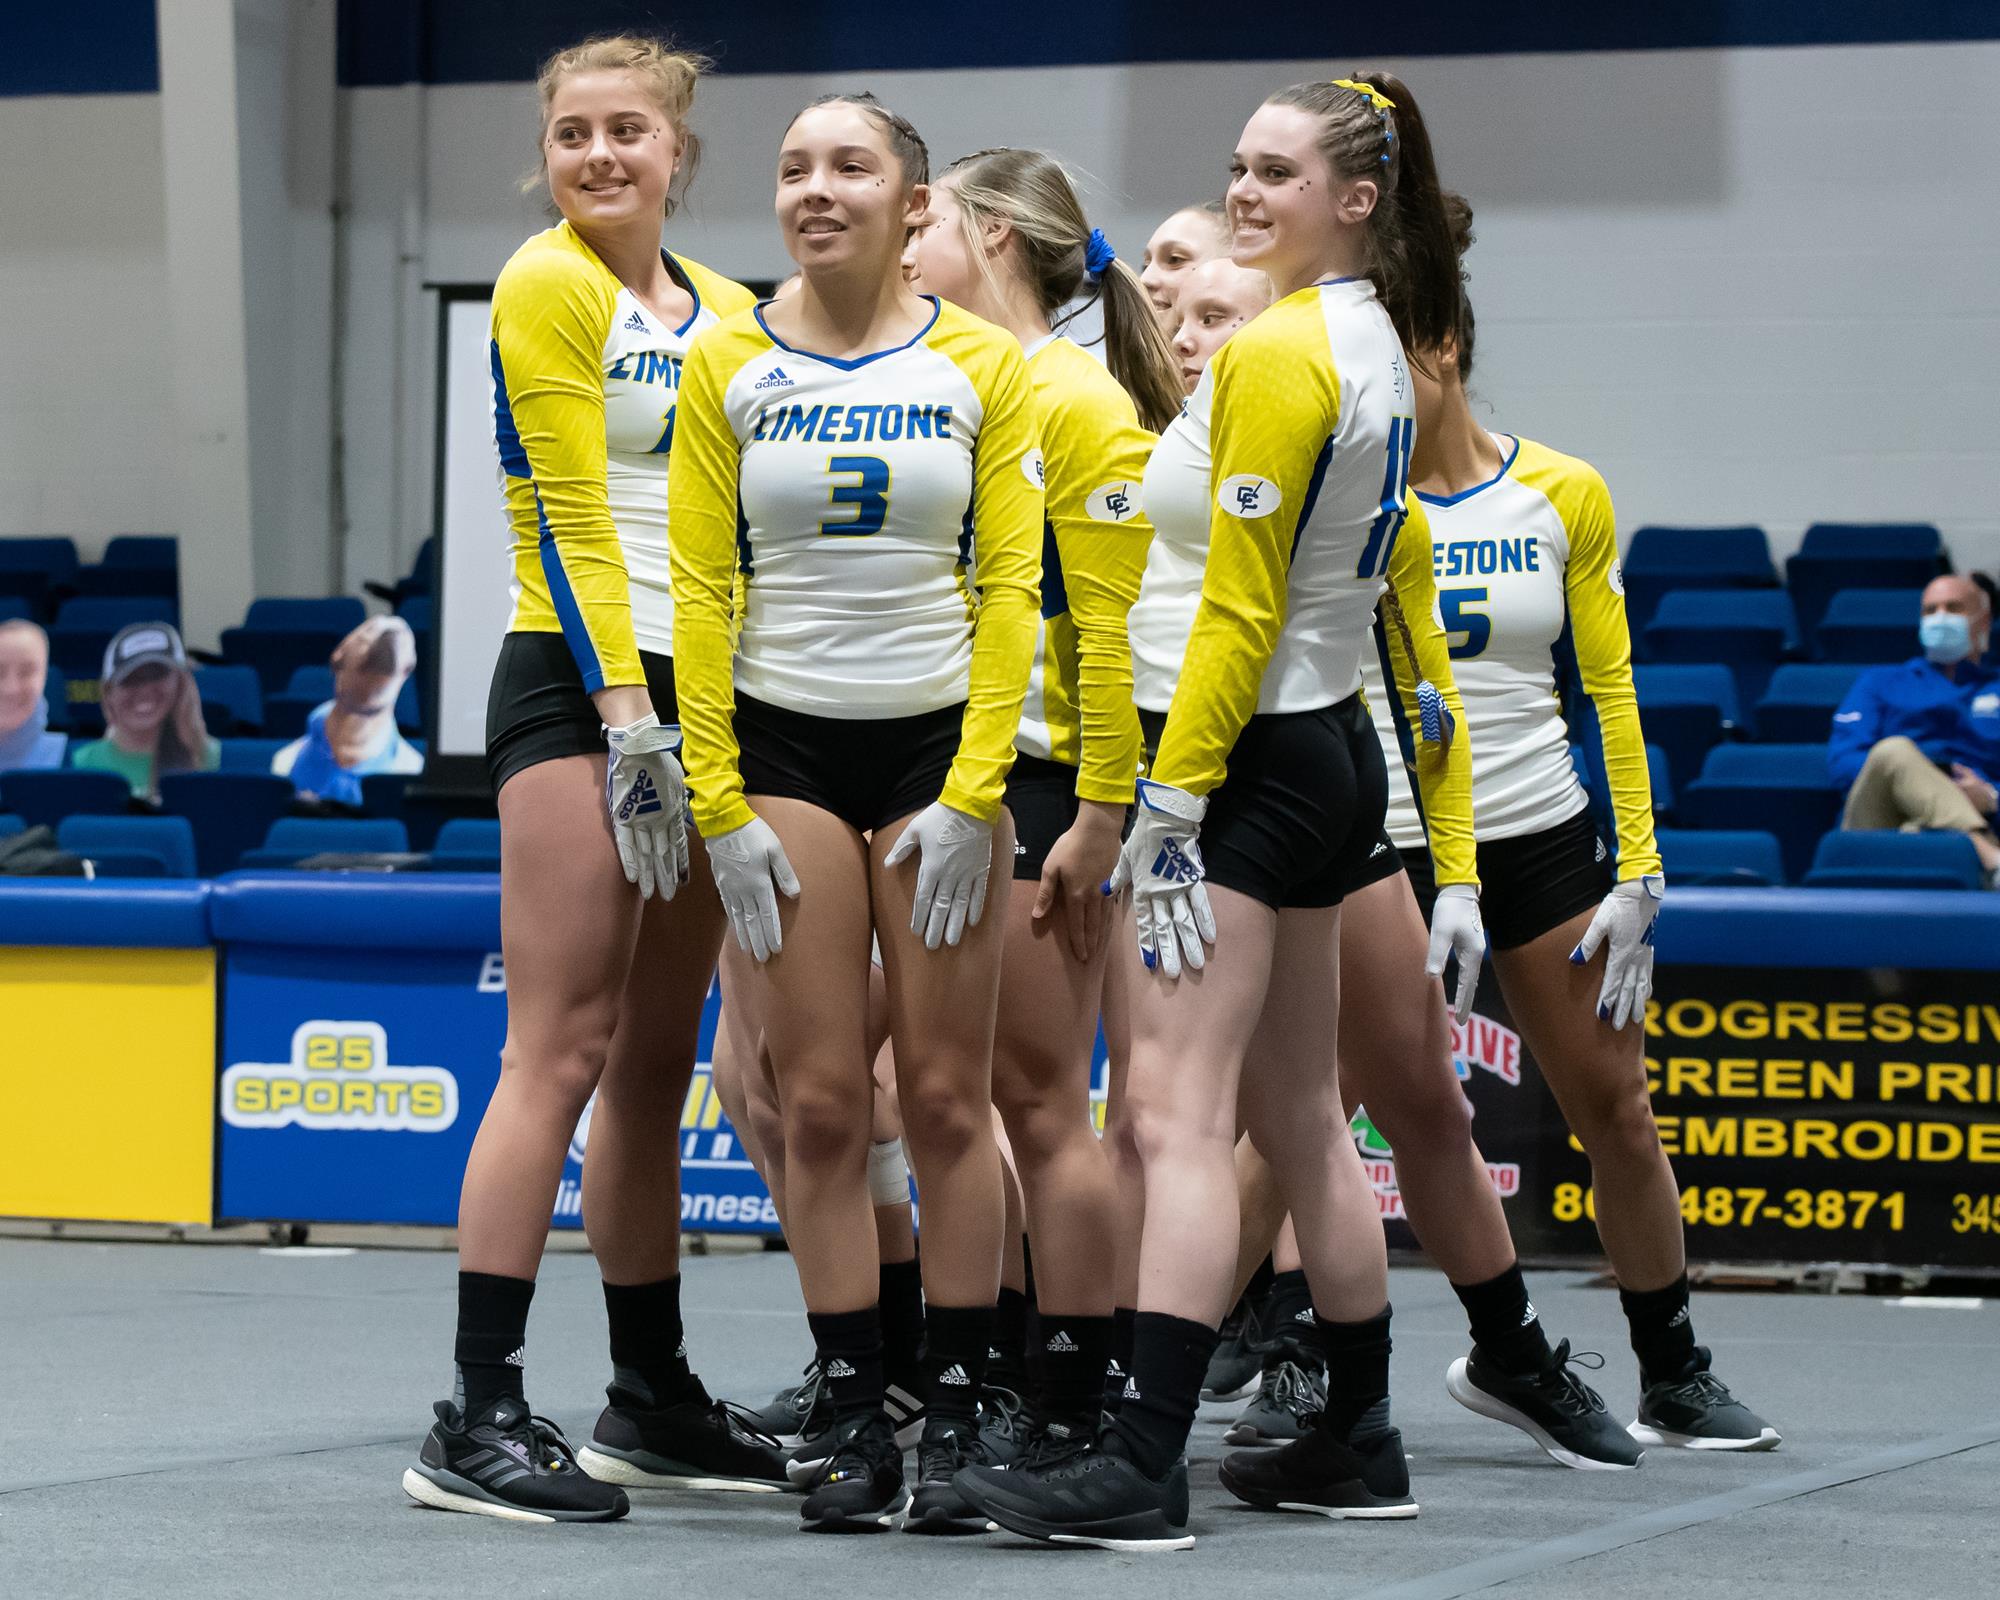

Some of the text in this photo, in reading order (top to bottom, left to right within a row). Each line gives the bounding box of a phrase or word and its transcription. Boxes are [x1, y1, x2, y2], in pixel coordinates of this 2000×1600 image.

[754, 376, 796, 390] adidas
[752, 403, 954, 444] LIMESTONE
[818, 454, 893, 538] 3
[1438, 586, 1493, 661] 5
[619, 768, 648, 820] adidas
[1162, 836, 1200, 883] adidas
[307, 1035, 374, 1071] 25
[234, 1077, 447, 1118] SPORTS
[1878, 1061, 2000, 1103] PRI
[1047, 1343, 1079, 1352] adidas
[939, 1375, 971, 1386] adidas
